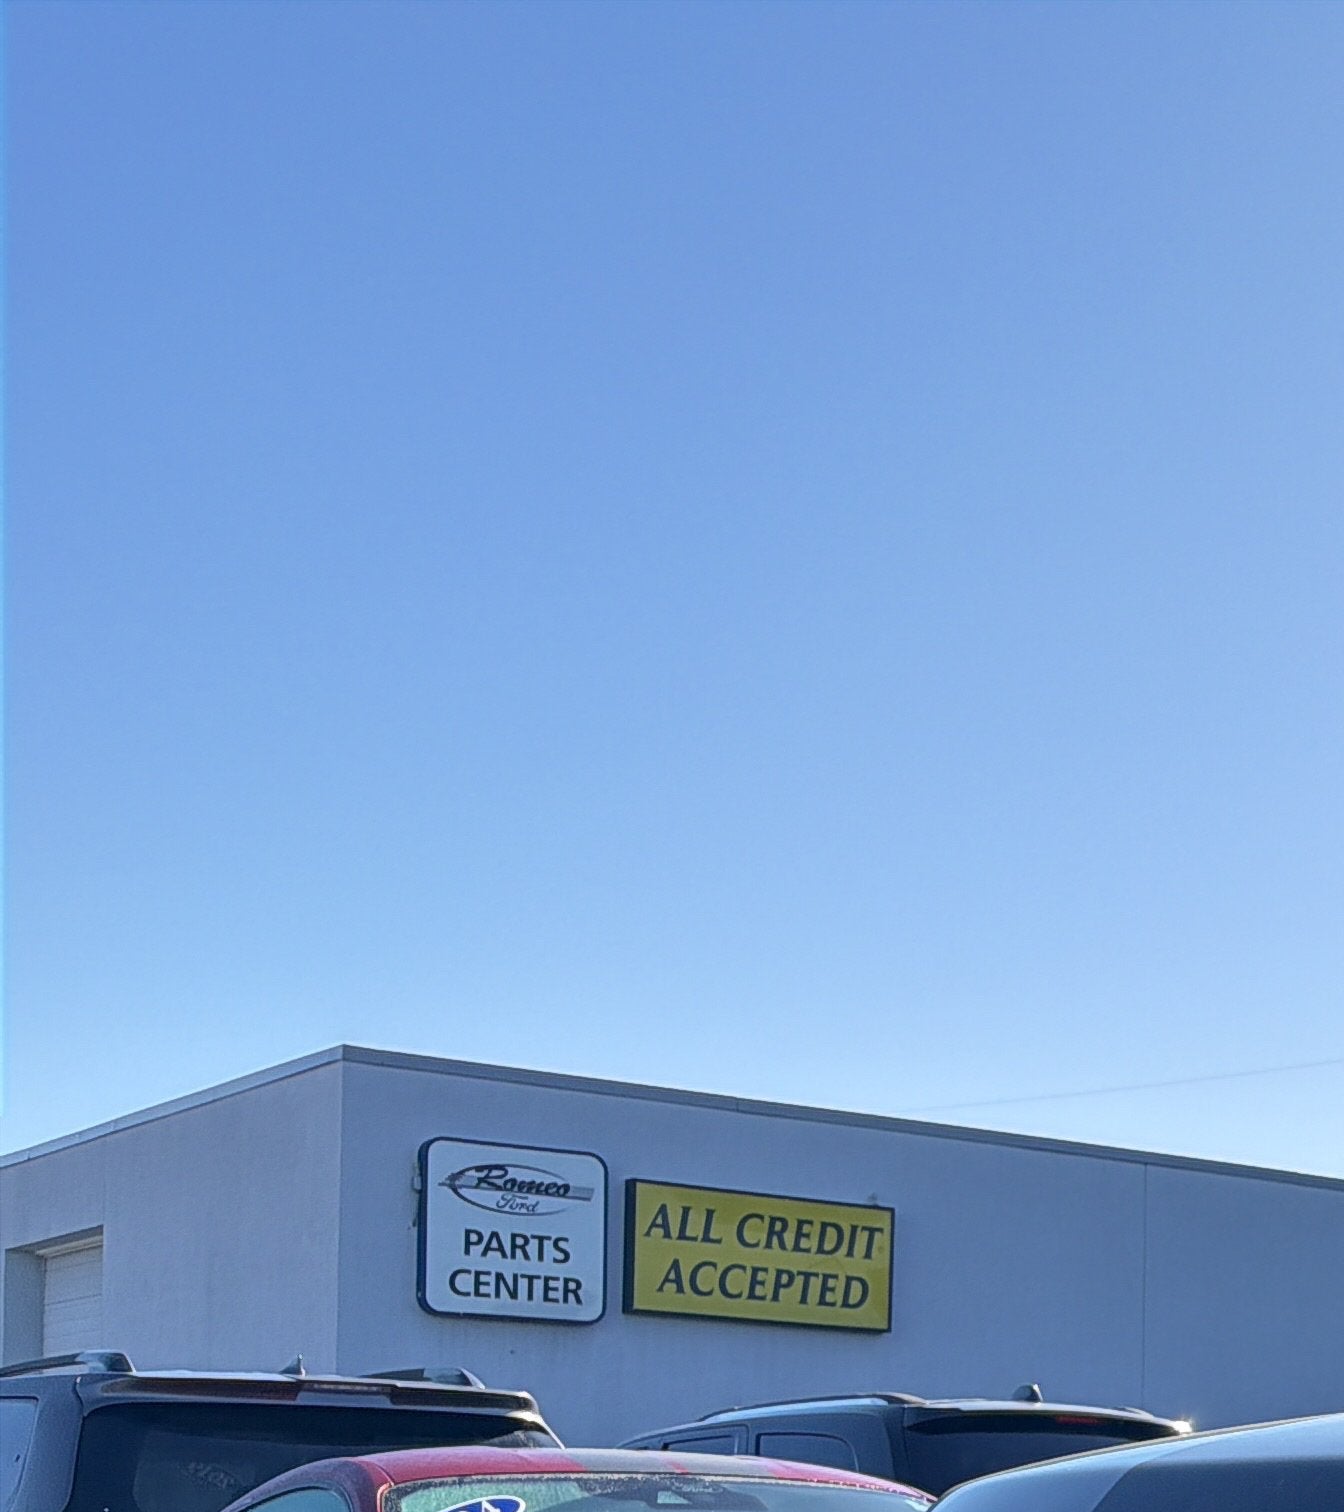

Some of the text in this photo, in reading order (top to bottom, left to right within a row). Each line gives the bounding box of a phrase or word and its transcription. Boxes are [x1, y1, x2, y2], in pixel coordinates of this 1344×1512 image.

[474, 1165, 571, 1197] Romeo
[496, 1193, 540, 1213] Ford
[463, 1228, 572, 1265] PARTS
[643, 1204, 883, 1260] ALL CREDIT
[448, 1269, 585, 1306] CENTER
[656, 1259, 870, 1310] ACCEPTED
